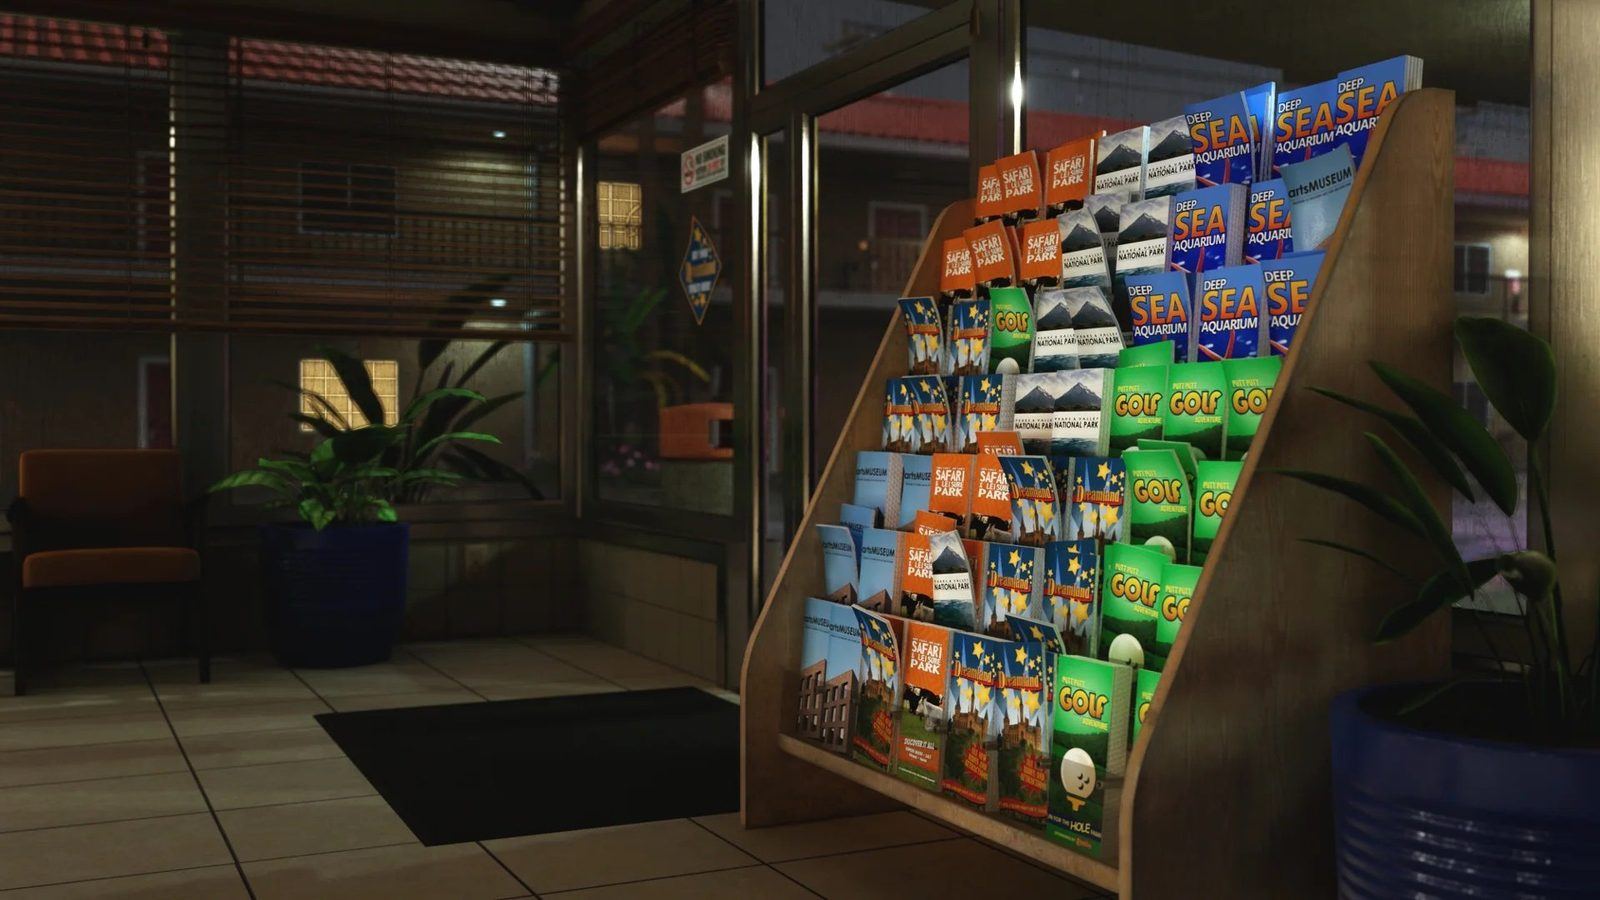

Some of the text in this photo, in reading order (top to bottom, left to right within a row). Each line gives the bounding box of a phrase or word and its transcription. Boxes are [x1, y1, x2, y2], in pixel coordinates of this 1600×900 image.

[1338, 78, 1364, 93] DEEP
[1278, 99, 1301, 113] DEEP
[1336, 81, 1398, 124] SEA
[1187, 111, 1211, 124] DEEP
[1277, 102, 1335, 142] SEA
[1190, 114, 1249, 153] SEA
[1336, 116, 1379, 136] AQUAR
[1276, 131, 1334, 154] AQUARIUM
[1196, 143, 1250, 164] AQUARIUM
[1054, 156, 1085, 174] SAFARI
[1148, 167, 1178, 178] NATIONAL
[1179, 163, 1195, 173] PARK
[1003, 166, 1032, 184] SAFARI
[1053, 174, 1083, 189] PARK
[1288, 167, 1352, 198] artsMUSEUM
[1096, 176, 1139, 190] NATIONAL PARK
[980, 194, 1002, 203] PAR
[1006, 184, 1034, 198] PARK
[1251, 190, 1274, 204] DEEP
[1176, 200, 1197, 212] DEEP
[1174, 205, 1226, 240] SEA
[973, 236, 1002, 254] SAFARI
[1028, 234, 1059, 250] SAFARI
[1174, 234, 1225, 252] AQUARIUM
[977, 253, 1005, 268] PARK
[1026, 251, 1057, 264] PARK
[1118, 247, 1165, 261] NATIONAL PARK
[1064, 256, 1103, 269] NATIONAL PARK
[946, 266, 971, 277] PARK
[1264, 270, 1294, 282] DEEP
[1128, 286, 1152, 296] DEEP
[1204, 279, 1226, 291] DEEP
[1202, 286, 1258, 321] SEA
[1267, 280, 1309, 314] SE
[1131, 293, 1186, 326] SEA
[995, 311, 1029, 332] GOLF
[1202, 317, 1258, 333] AQUARIUM
[1134, 323, 1187, 339] AQUARIUM
[1037, 338, 1063, 347] NATIONAL
[1077, 336, 1120, 346] NATIONAL PARK
[1115, 392, 1163, 416] GOLF
[1169, 390, 1222, 415] GOLF
[1015, 422, 1040, 430] NATIONAL
[936, 469, 965, 482] SAFARI
[934, 487, 963, 497] PARK
[978, 488, 1008, 501] PARK
[1133, 478, 1182, 504] GOLF
[958, 582, 970, 590] PARK
[1111, 572, 1160, 608] GOLF
[912, 640, 943, 660] SAFARI
[910, 659, 940, 675] PARK
[1059, 685, 1109, 720] GOLF
[1070, 821, 1090, 834] HOLE
